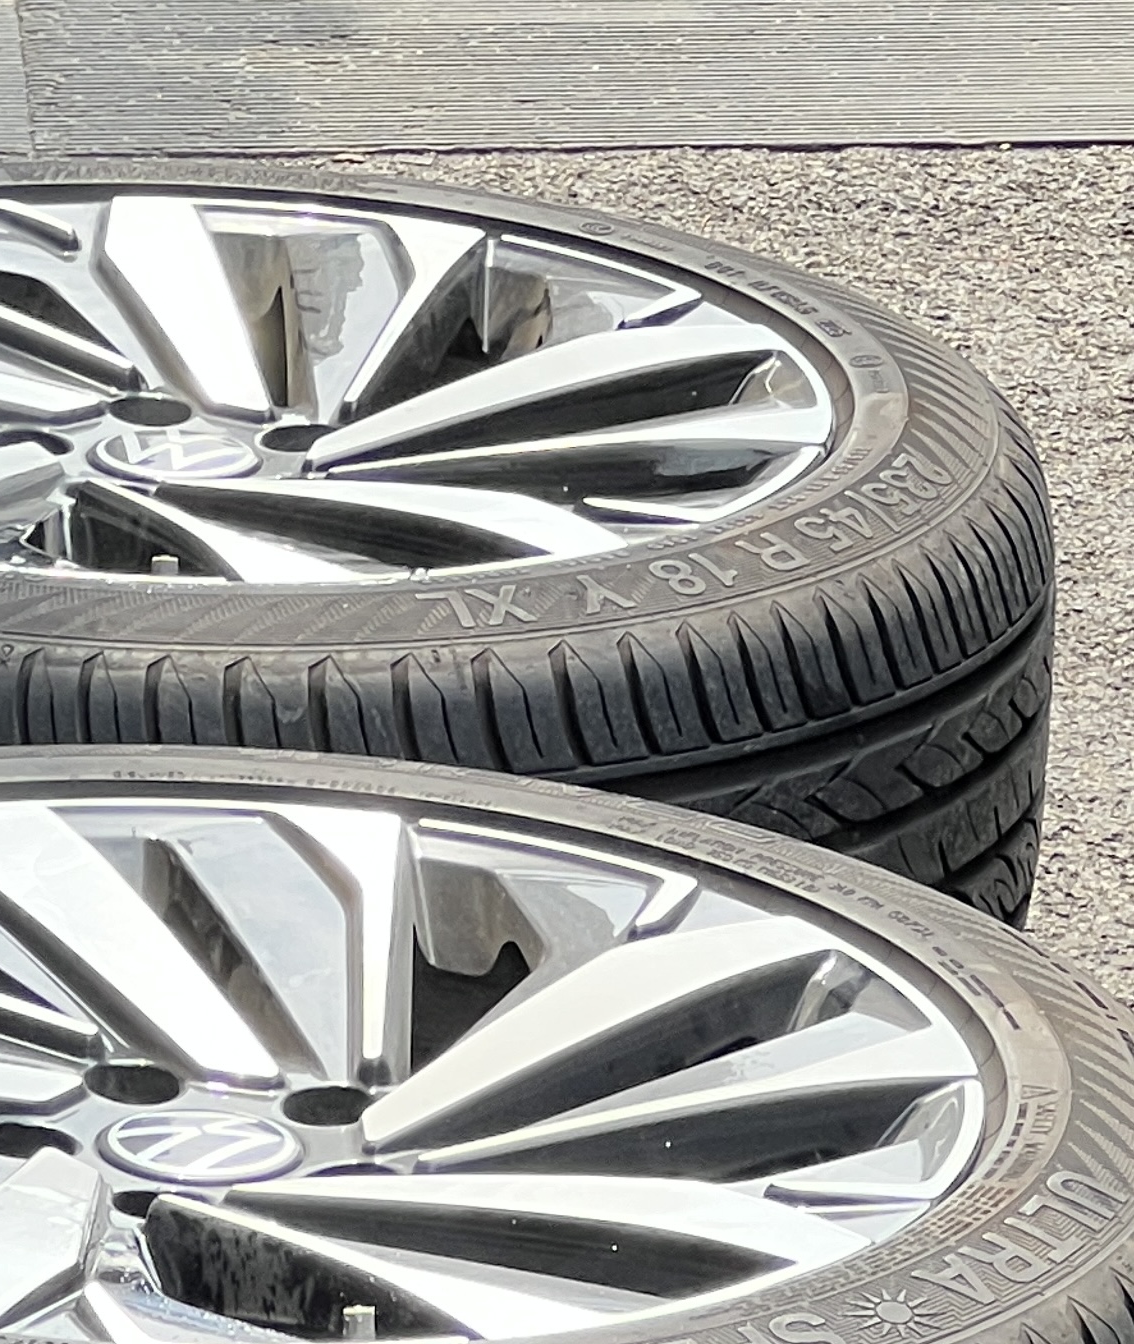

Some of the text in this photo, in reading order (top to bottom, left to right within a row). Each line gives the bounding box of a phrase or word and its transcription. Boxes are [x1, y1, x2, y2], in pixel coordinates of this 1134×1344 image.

[793, 452, 952, 555] 235/45
[647, 552, 740, 598] 18
[739, 533, 813, 573] R
[415, 583, 539, 630] XL
[578, 572, 636, 615] Y
[911, 1169, 1132, 1307] ULTRA
